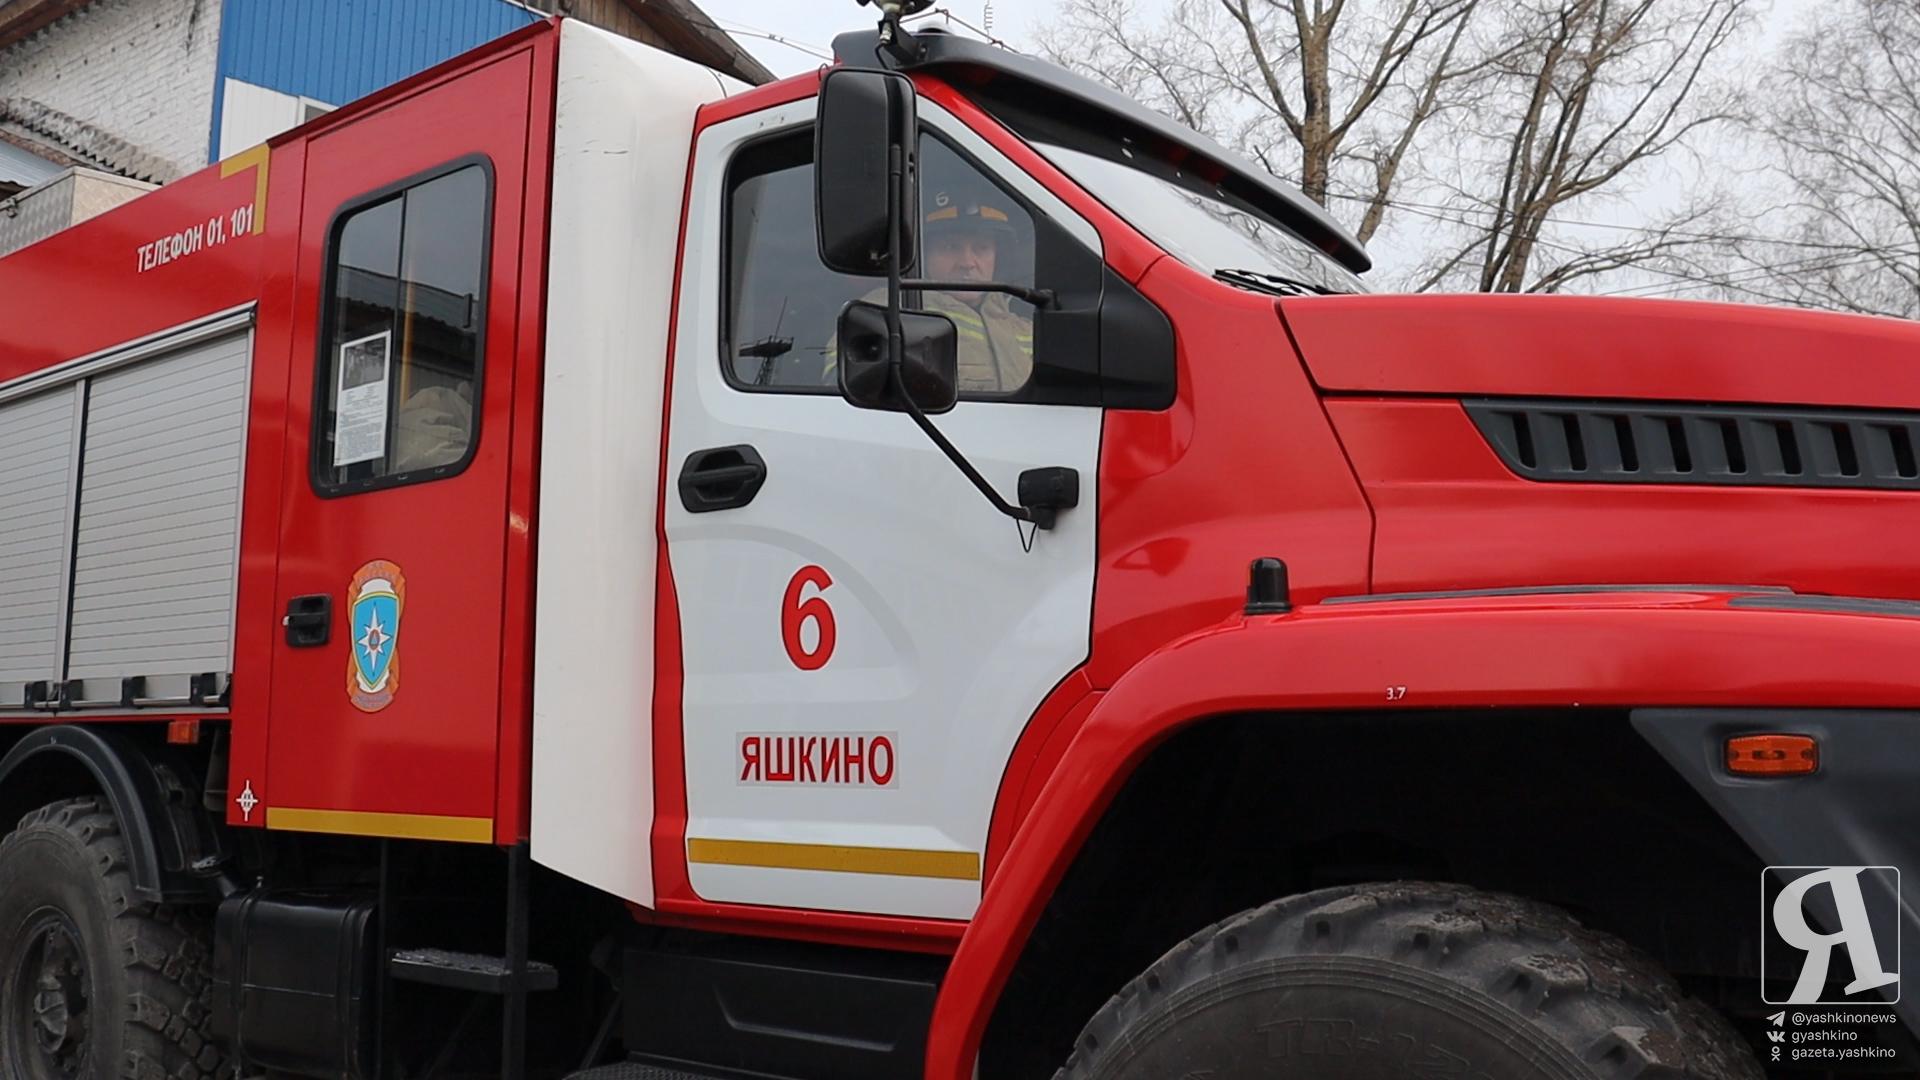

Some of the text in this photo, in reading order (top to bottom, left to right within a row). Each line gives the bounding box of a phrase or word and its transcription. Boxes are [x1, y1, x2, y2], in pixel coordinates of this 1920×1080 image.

[137, 203, 254, 273] ТЕЛЕФОН 01, 101
[780, 564, 836, 671] 6
[1386, 686, 1406, 700] 3.7
[740, 735, 894, 786] ЯШКИНО
